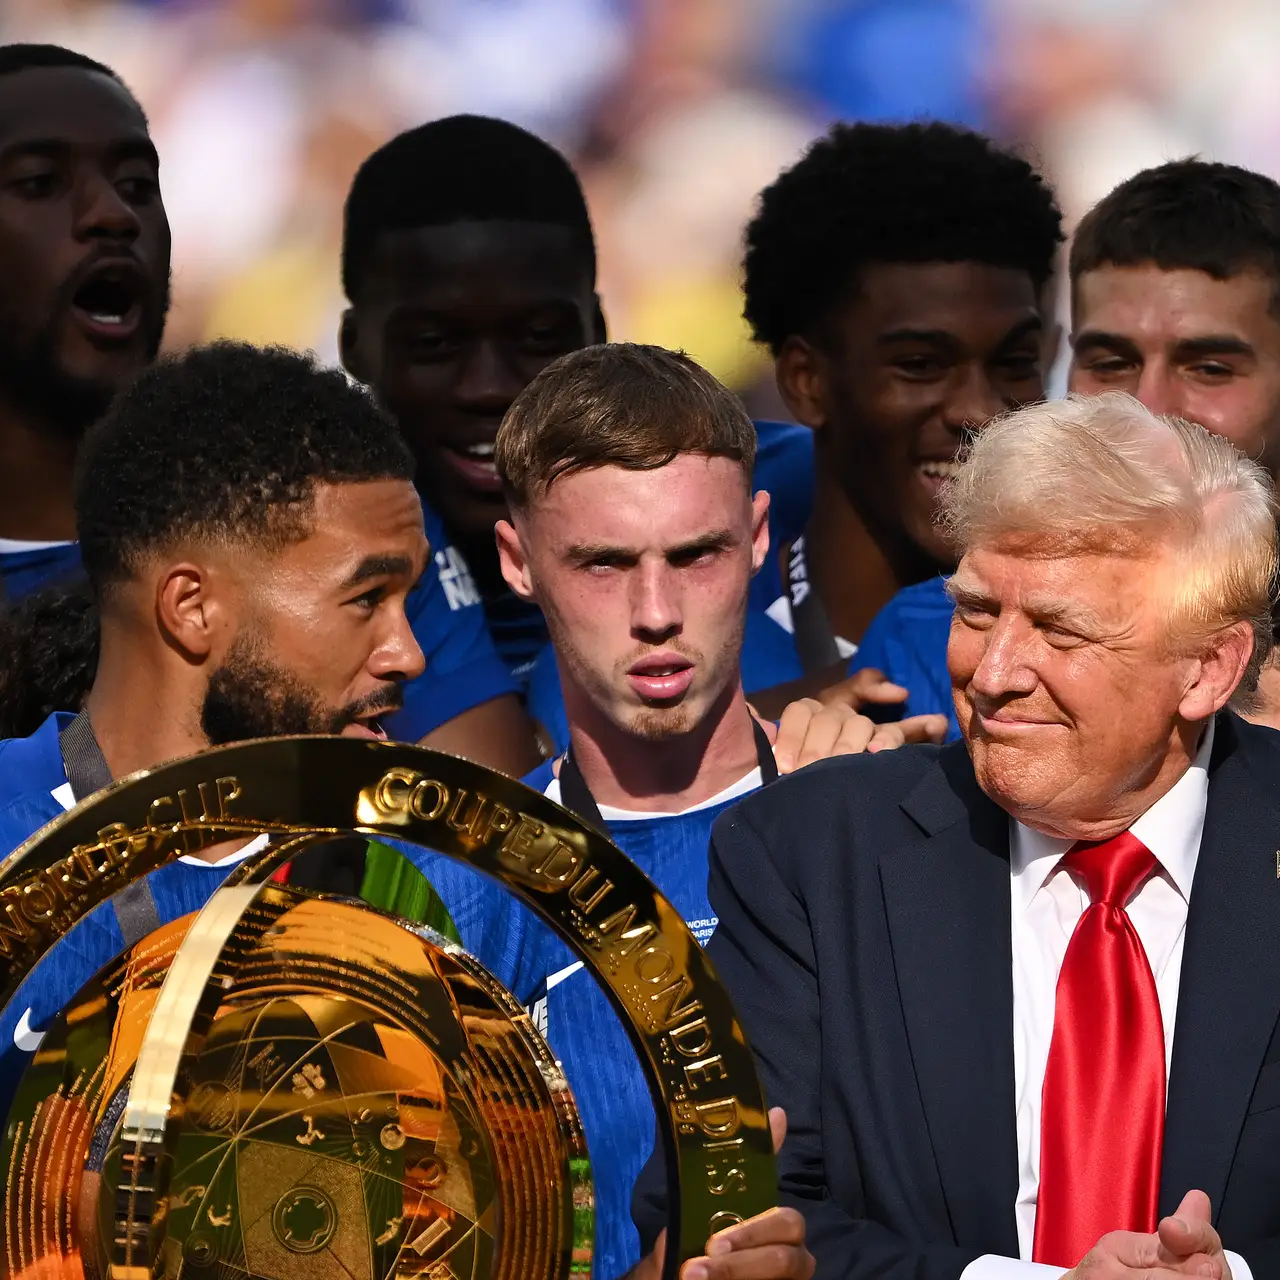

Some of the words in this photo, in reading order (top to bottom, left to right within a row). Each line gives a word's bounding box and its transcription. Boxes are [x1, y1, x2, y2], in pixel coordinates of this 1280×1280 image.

[148, 775, 245, 834] CUP
[686, 917, 719, 929] WORLD
[691, 928, 713, 938] ARIS
[374, 766, 544, 862] COUPE
[533, 838, 616, 913] DU
[599, 902, 726, 1092] MONDE
[695, 1096, 749, 1198] DES
